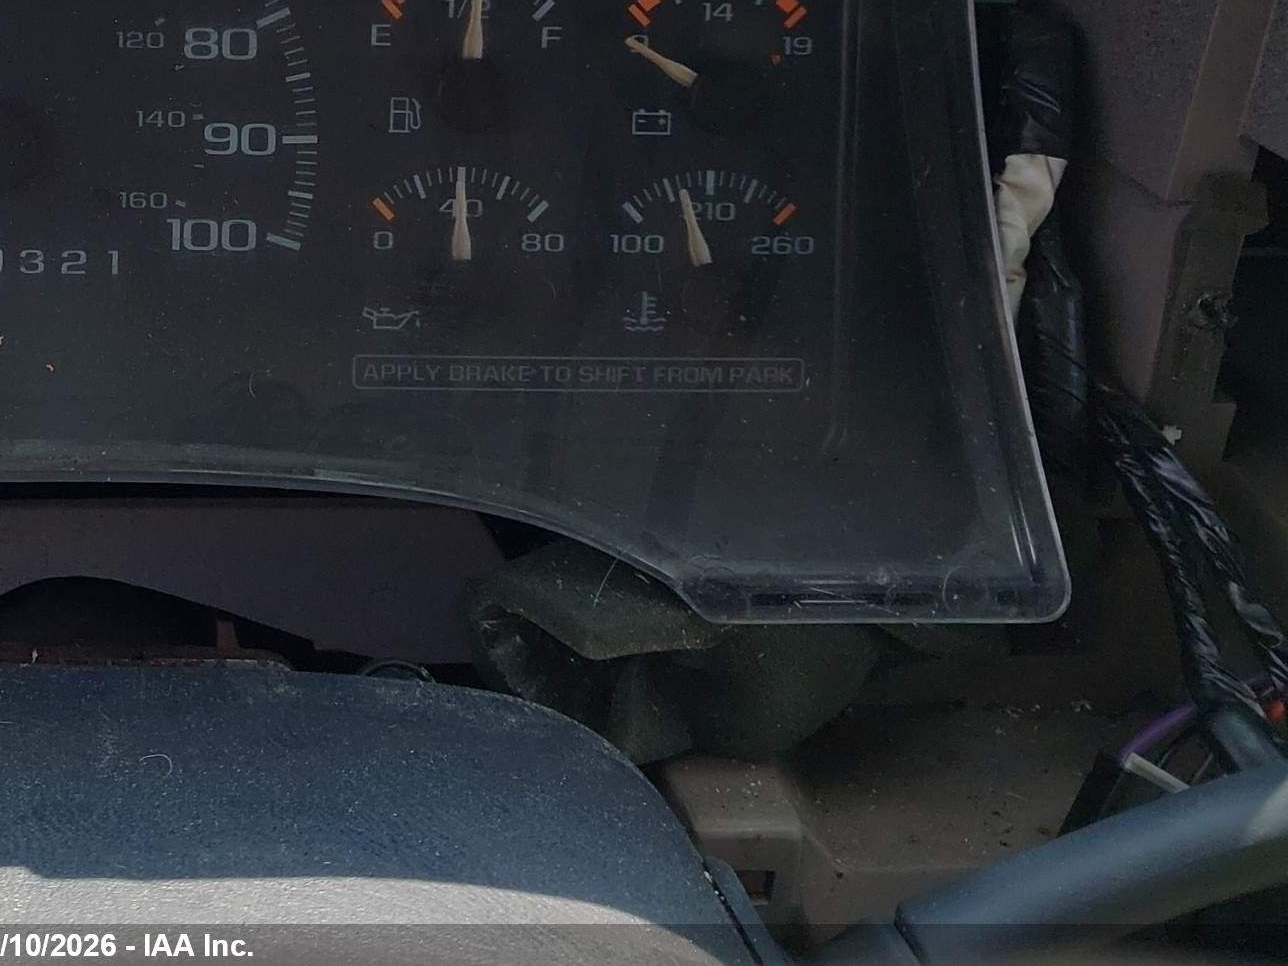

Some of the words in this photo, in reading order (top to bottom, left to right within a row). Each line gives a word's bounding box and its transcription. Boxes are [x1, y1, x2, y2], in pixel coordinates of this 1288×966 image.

[703, 3, 733, 21] 14
[117, 31, 164, 48] 120
[184, 28, 258, 60] 80
[371, 24, 391, 46] E
[541, 27, 562, 48] F
[783, 37, 812, 55] 19
[136, 110, 185, 127] 140
[204, 123, 276, 155] 90
[120, 192, 168, 208] 160
[167, 219, 256, 251] 100
[374, 231, 393, 249] 0
[522, 234, 564, 251] 80
[611, 235, 664, 253] 100
[752, 236, 814, 254] 260
[363, 364, 440, 380] APPLY
[540, 365, 571, 381] TO
[578, 365, 646, 383] SHIFT
[654, 366, 722, 383] FROM
[730, 367, 793, 383] PARK
